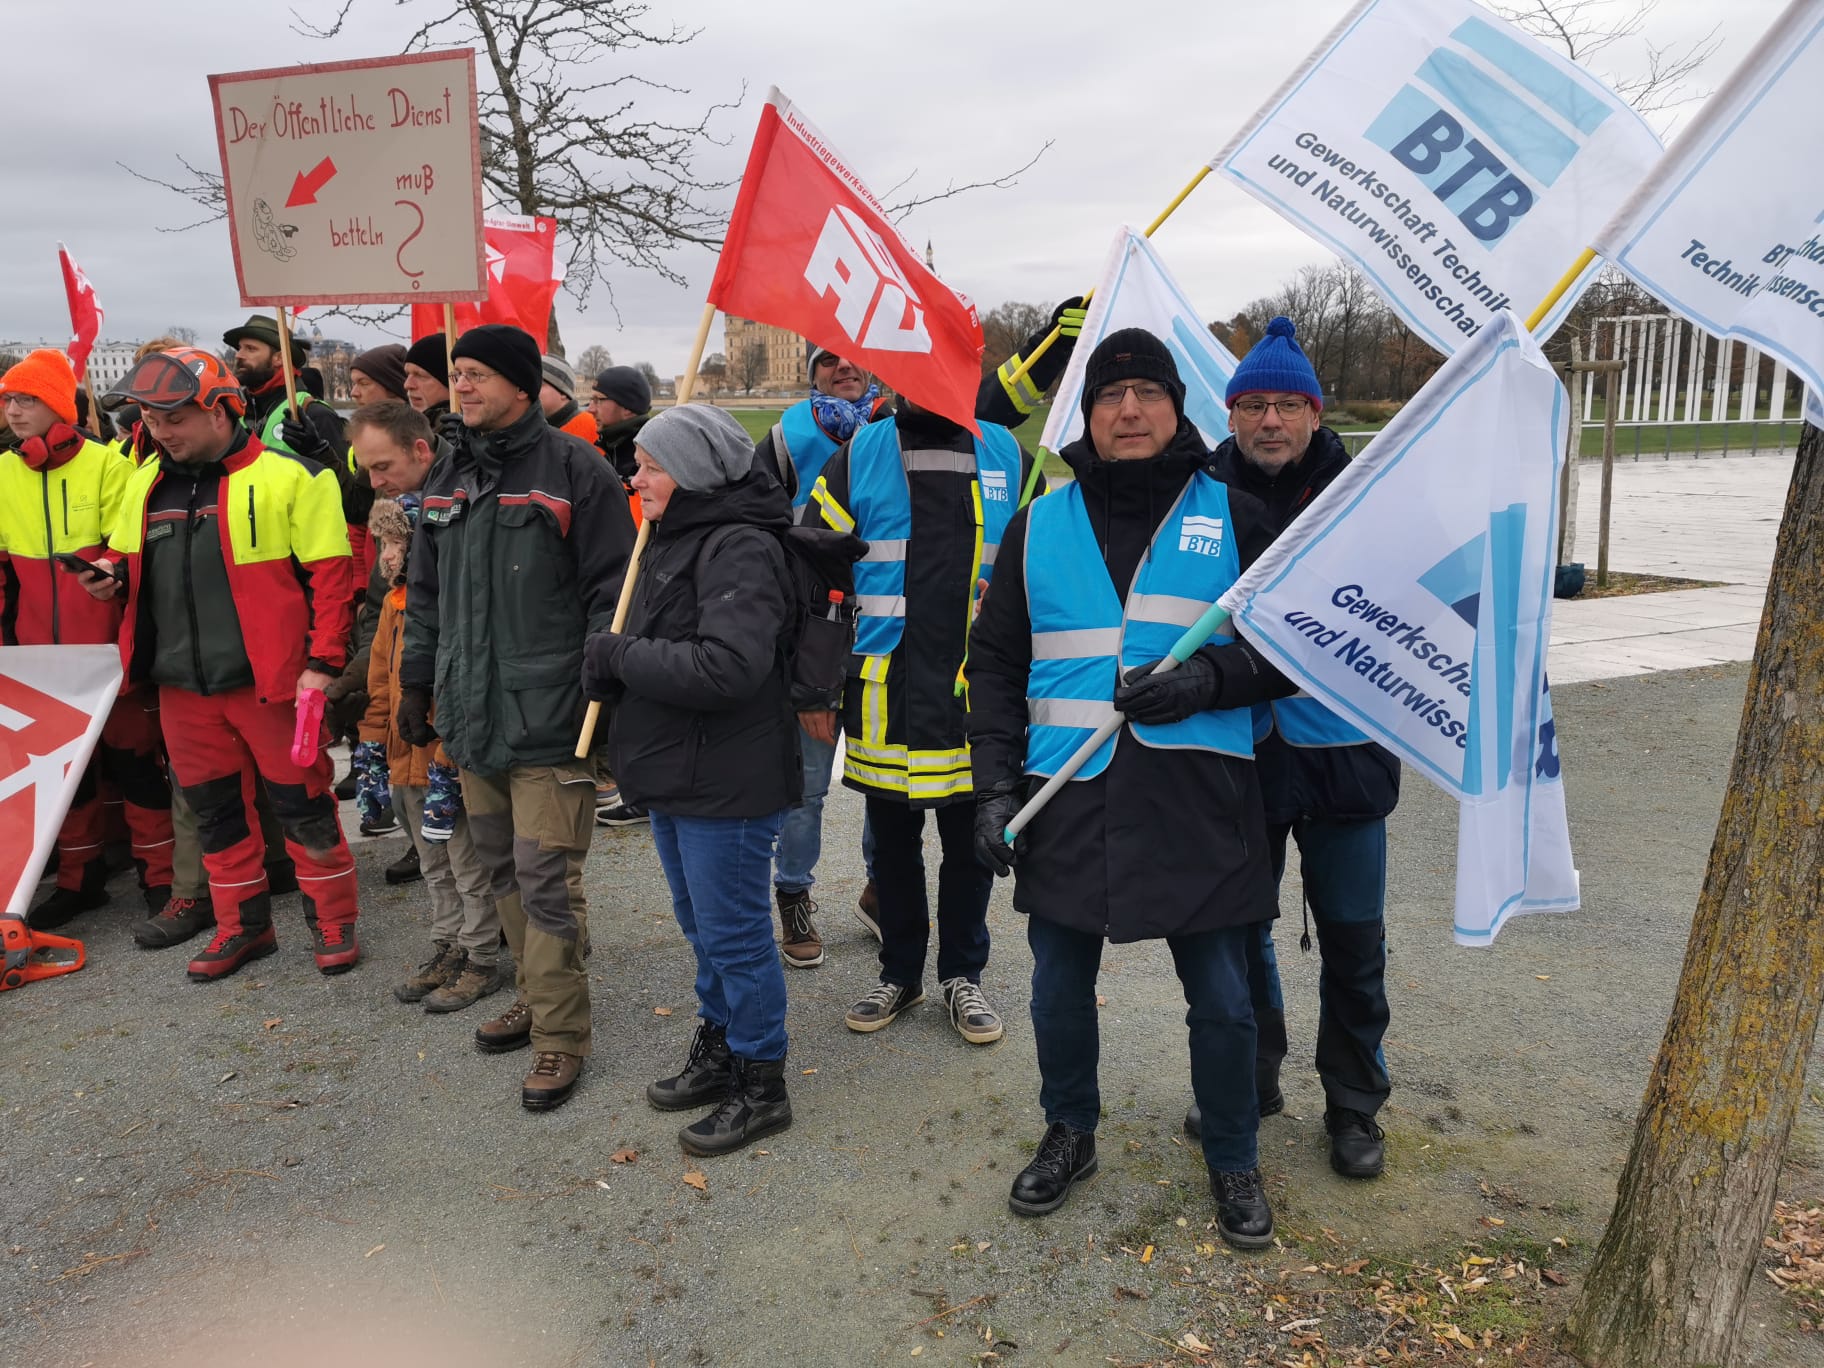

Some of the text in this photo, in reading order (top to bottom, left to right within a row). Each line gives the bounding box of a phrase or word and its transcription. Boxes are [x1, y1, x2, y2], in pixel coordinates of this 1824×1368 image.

[229, 87, 451, 143] Der Öffentliche Dienst
[396, 164, 434, 195] muß
[1267, 153, 1316, 187] und
[1390, 109, 1533, 241] BTB
[330, 200, 425, 290] betteln ?
[1295, 132, 1512, 312] Gewerkschaft Technik
[1680, 239, 1760, 298] Technik
[988, 487, 1008, 501] BTB
[1187, 536, 1220, 556] BTB
[1331, 584, 1471, 697] Gewerkscha
[1284, 610, 1339, 649] und
[1334, 637, 1467, 749] Naturwisse
